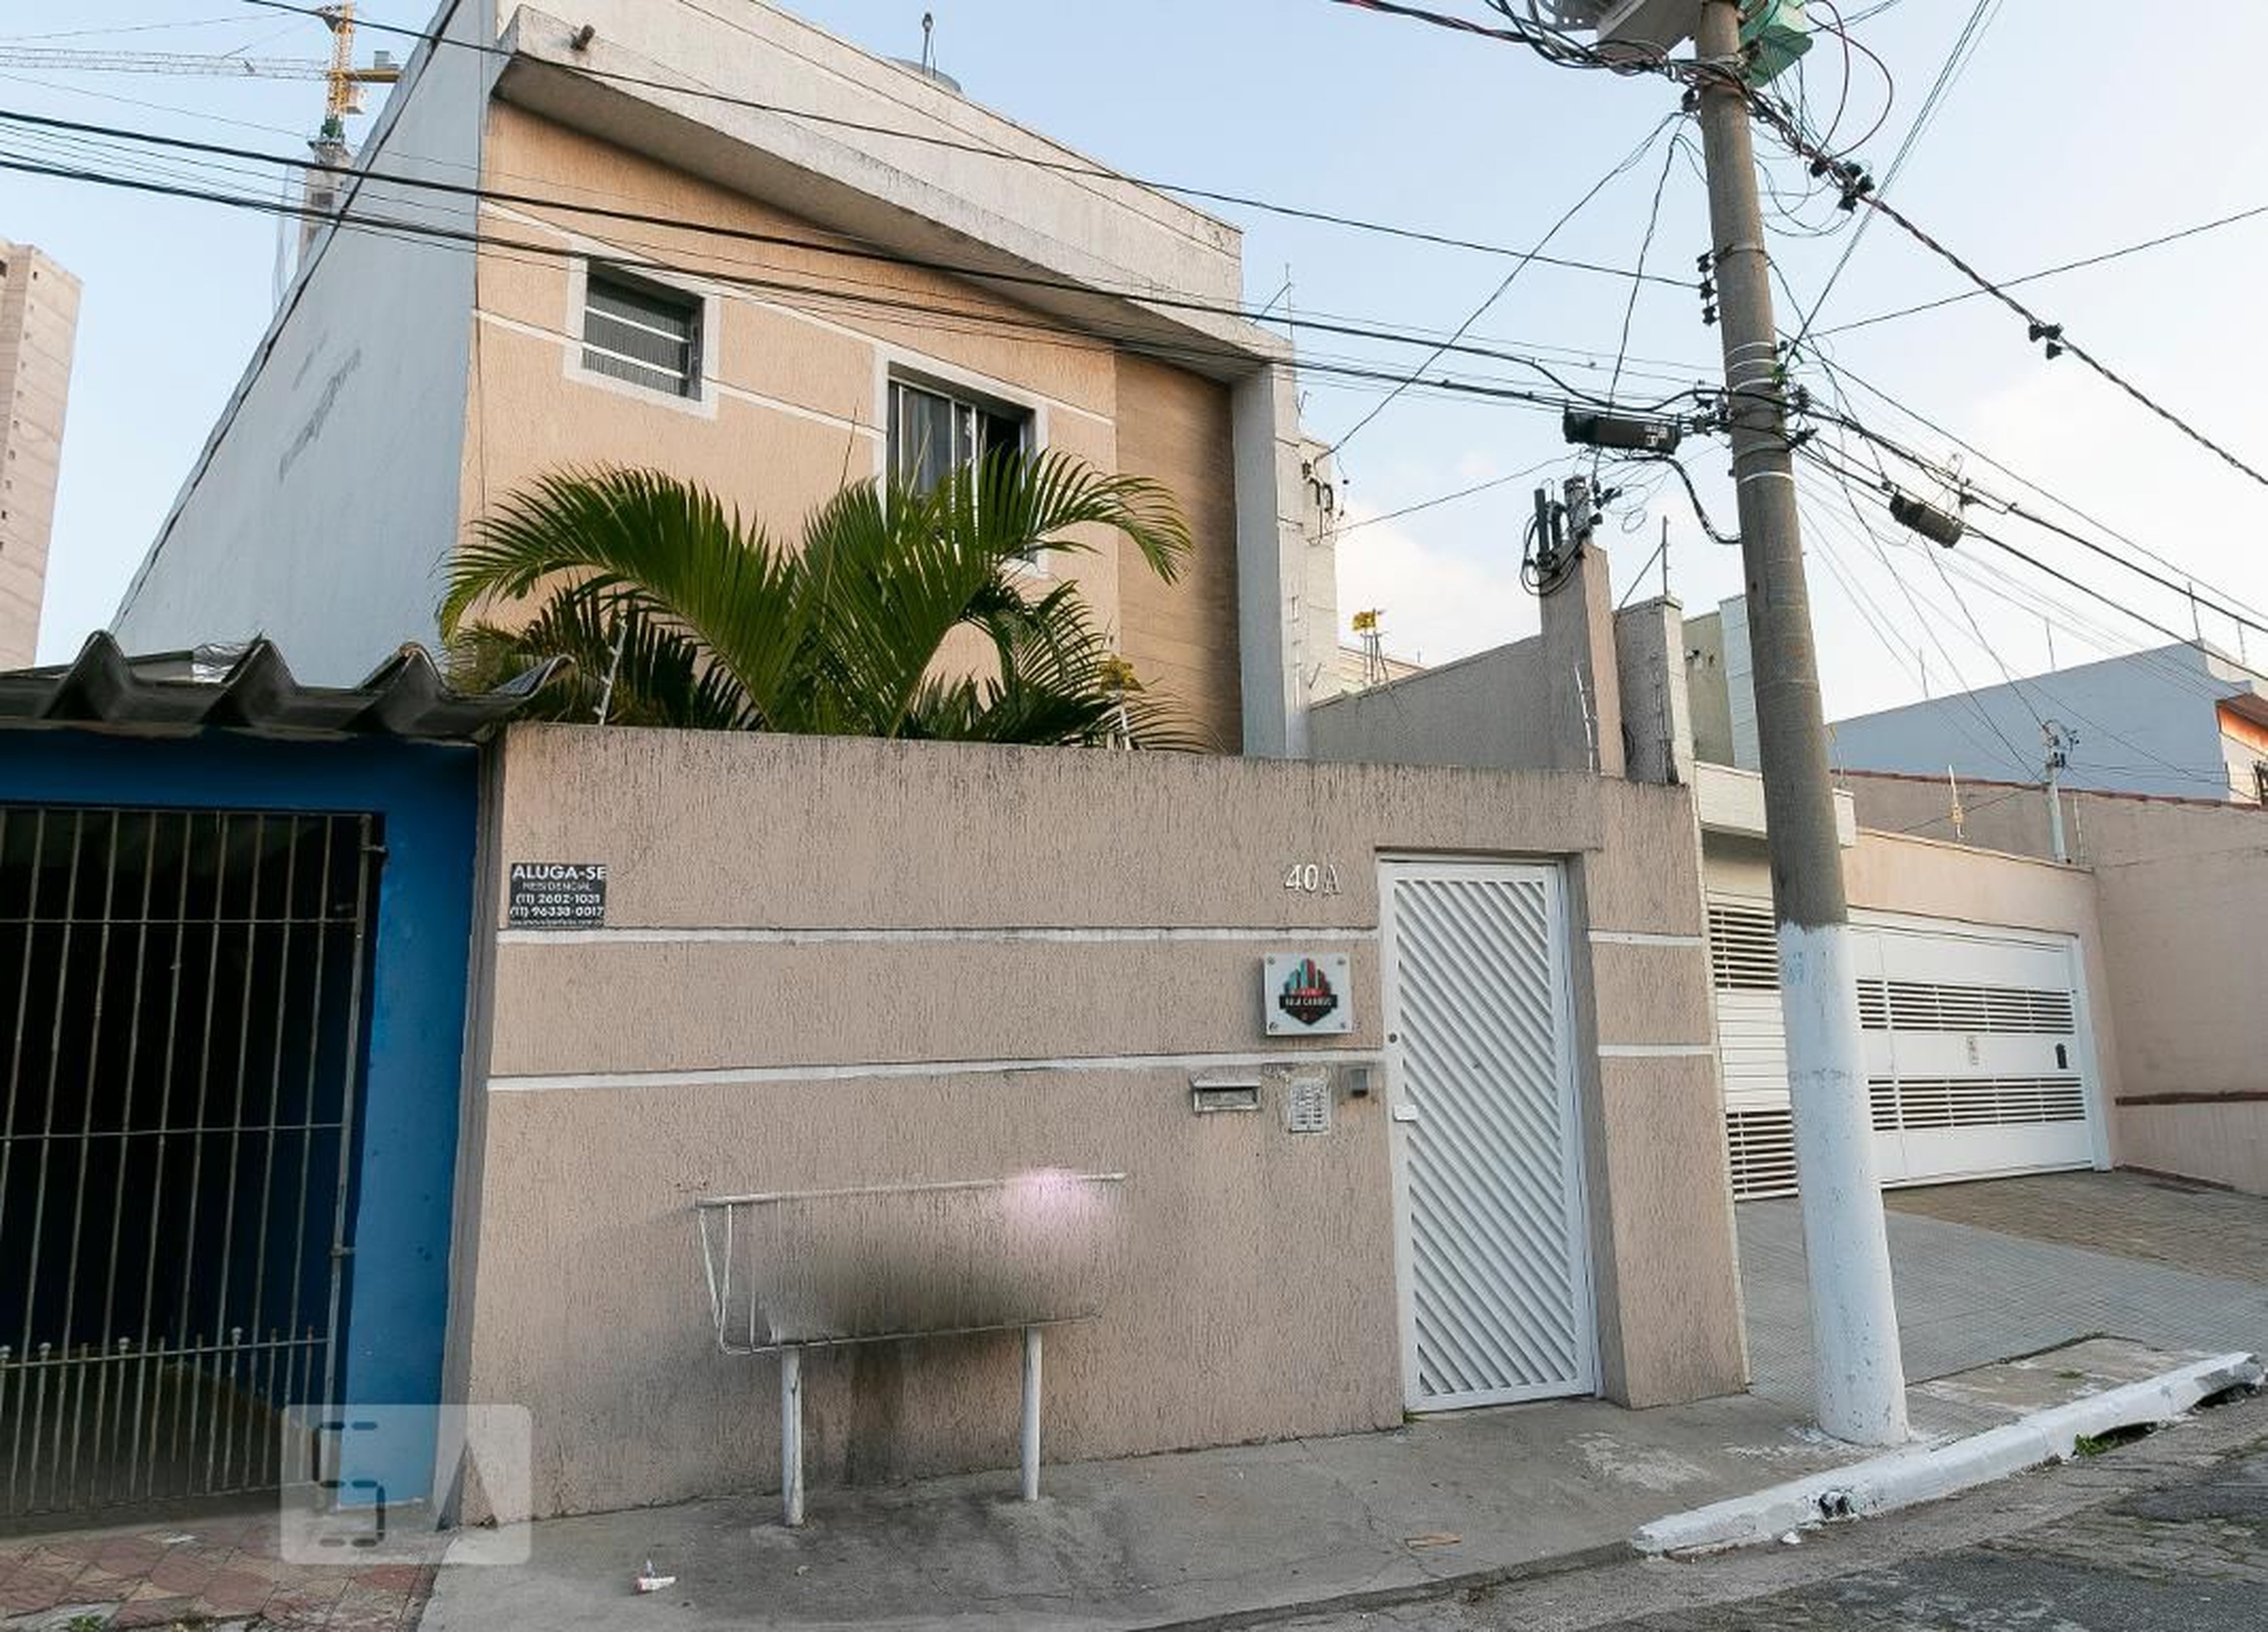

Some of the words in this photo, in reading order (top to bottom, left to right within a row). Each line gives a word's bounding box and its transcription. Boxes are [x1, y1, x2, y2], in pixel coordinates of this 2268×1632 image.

[512, 864, 607, 880] ALUGA-SE
[516, 893, 535, 905] (11)
[509, 906, 529, 918] (11)
